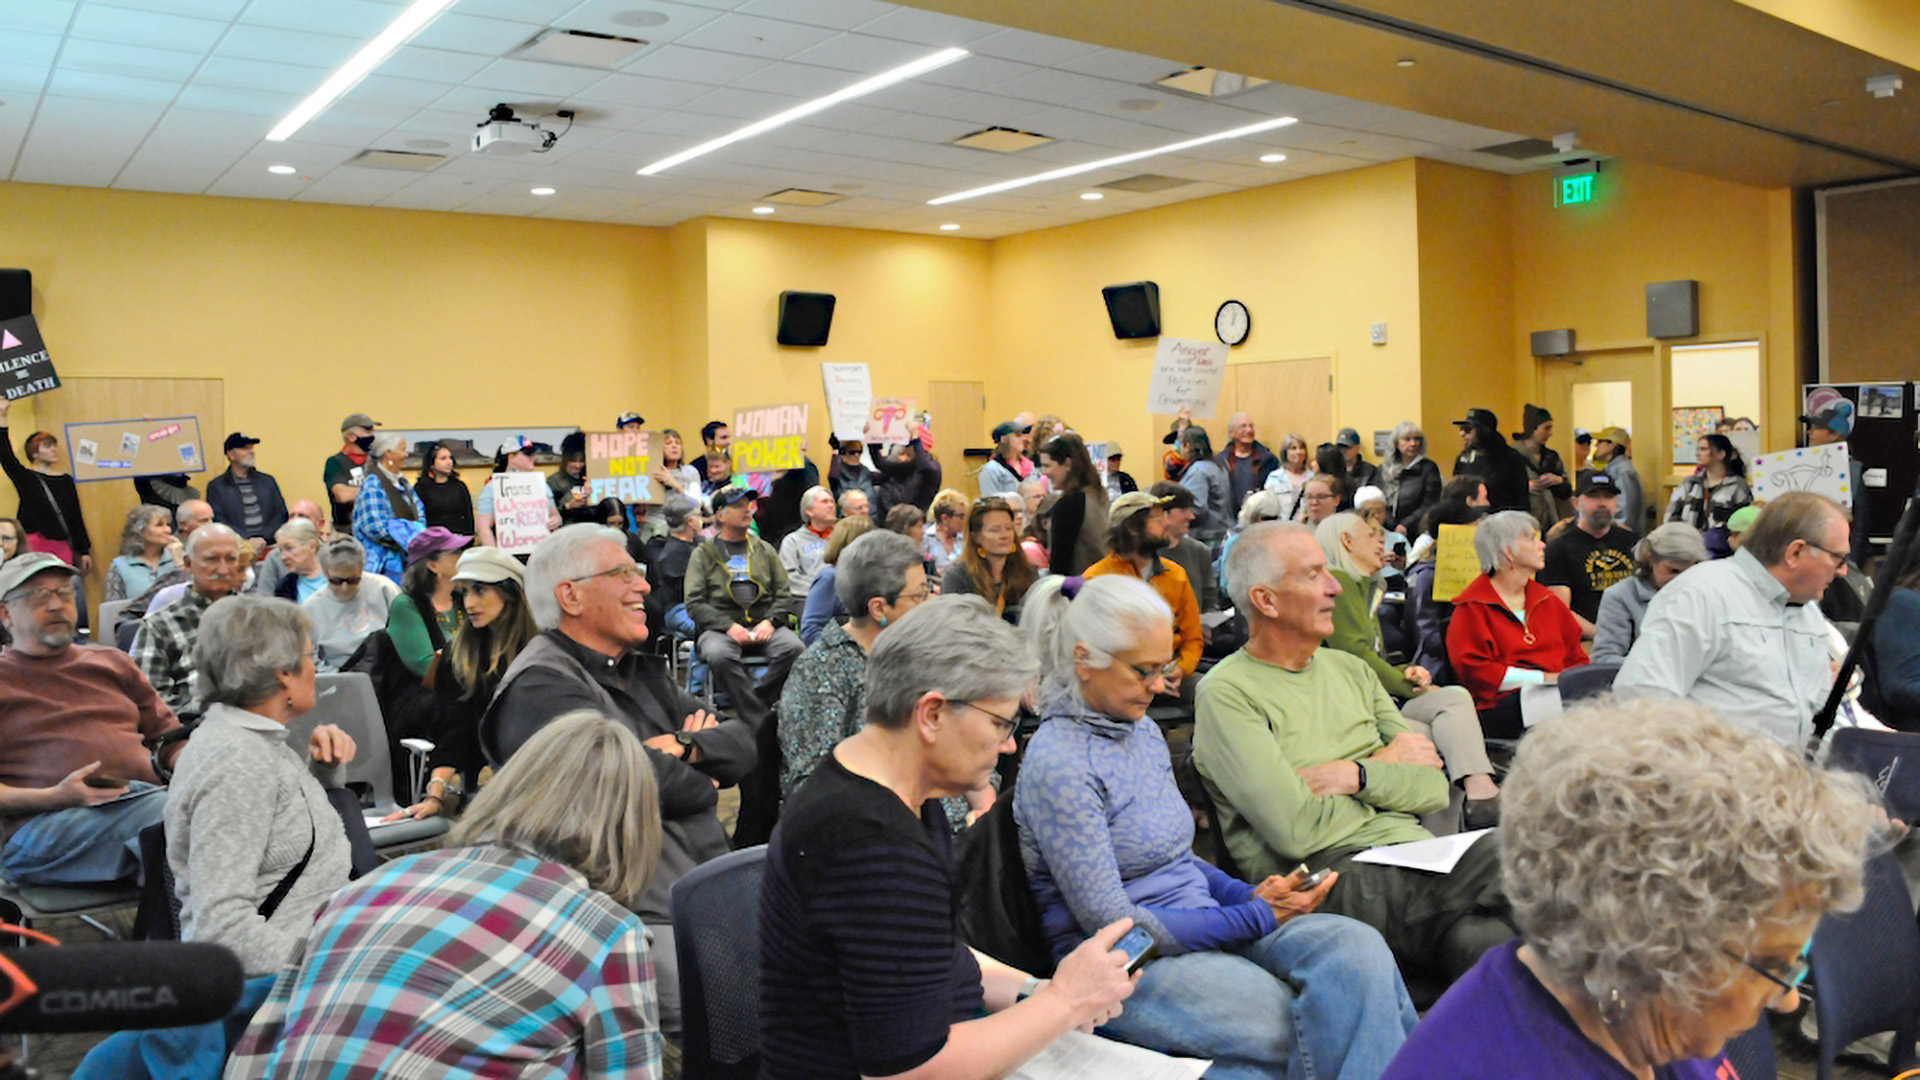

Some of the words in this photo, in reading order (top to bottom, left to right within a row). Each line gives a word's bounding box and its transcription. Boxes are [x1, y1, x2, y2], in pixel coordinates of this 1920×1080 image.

[1562, 176, 1593, 204] EXIT
[0, 349, 50, 373] ILENCE
[1171, 342, 1210, 360] Anger
[6, 377, 55, 400] DEATH
[735, 403, 809, 438] WOMAN
[591, 432, 650, 459] HOPE
[732, 437, 804, 473] POWER
[609, 456, 650, 477] NOT
[494, 476, 532, 497] Trans
[591, 475, 653, 504] FEAR
[496, 499, 548, 513] Women
[499, 517, 514, 525] are
[40, 985, 178, 1014] COMICA
